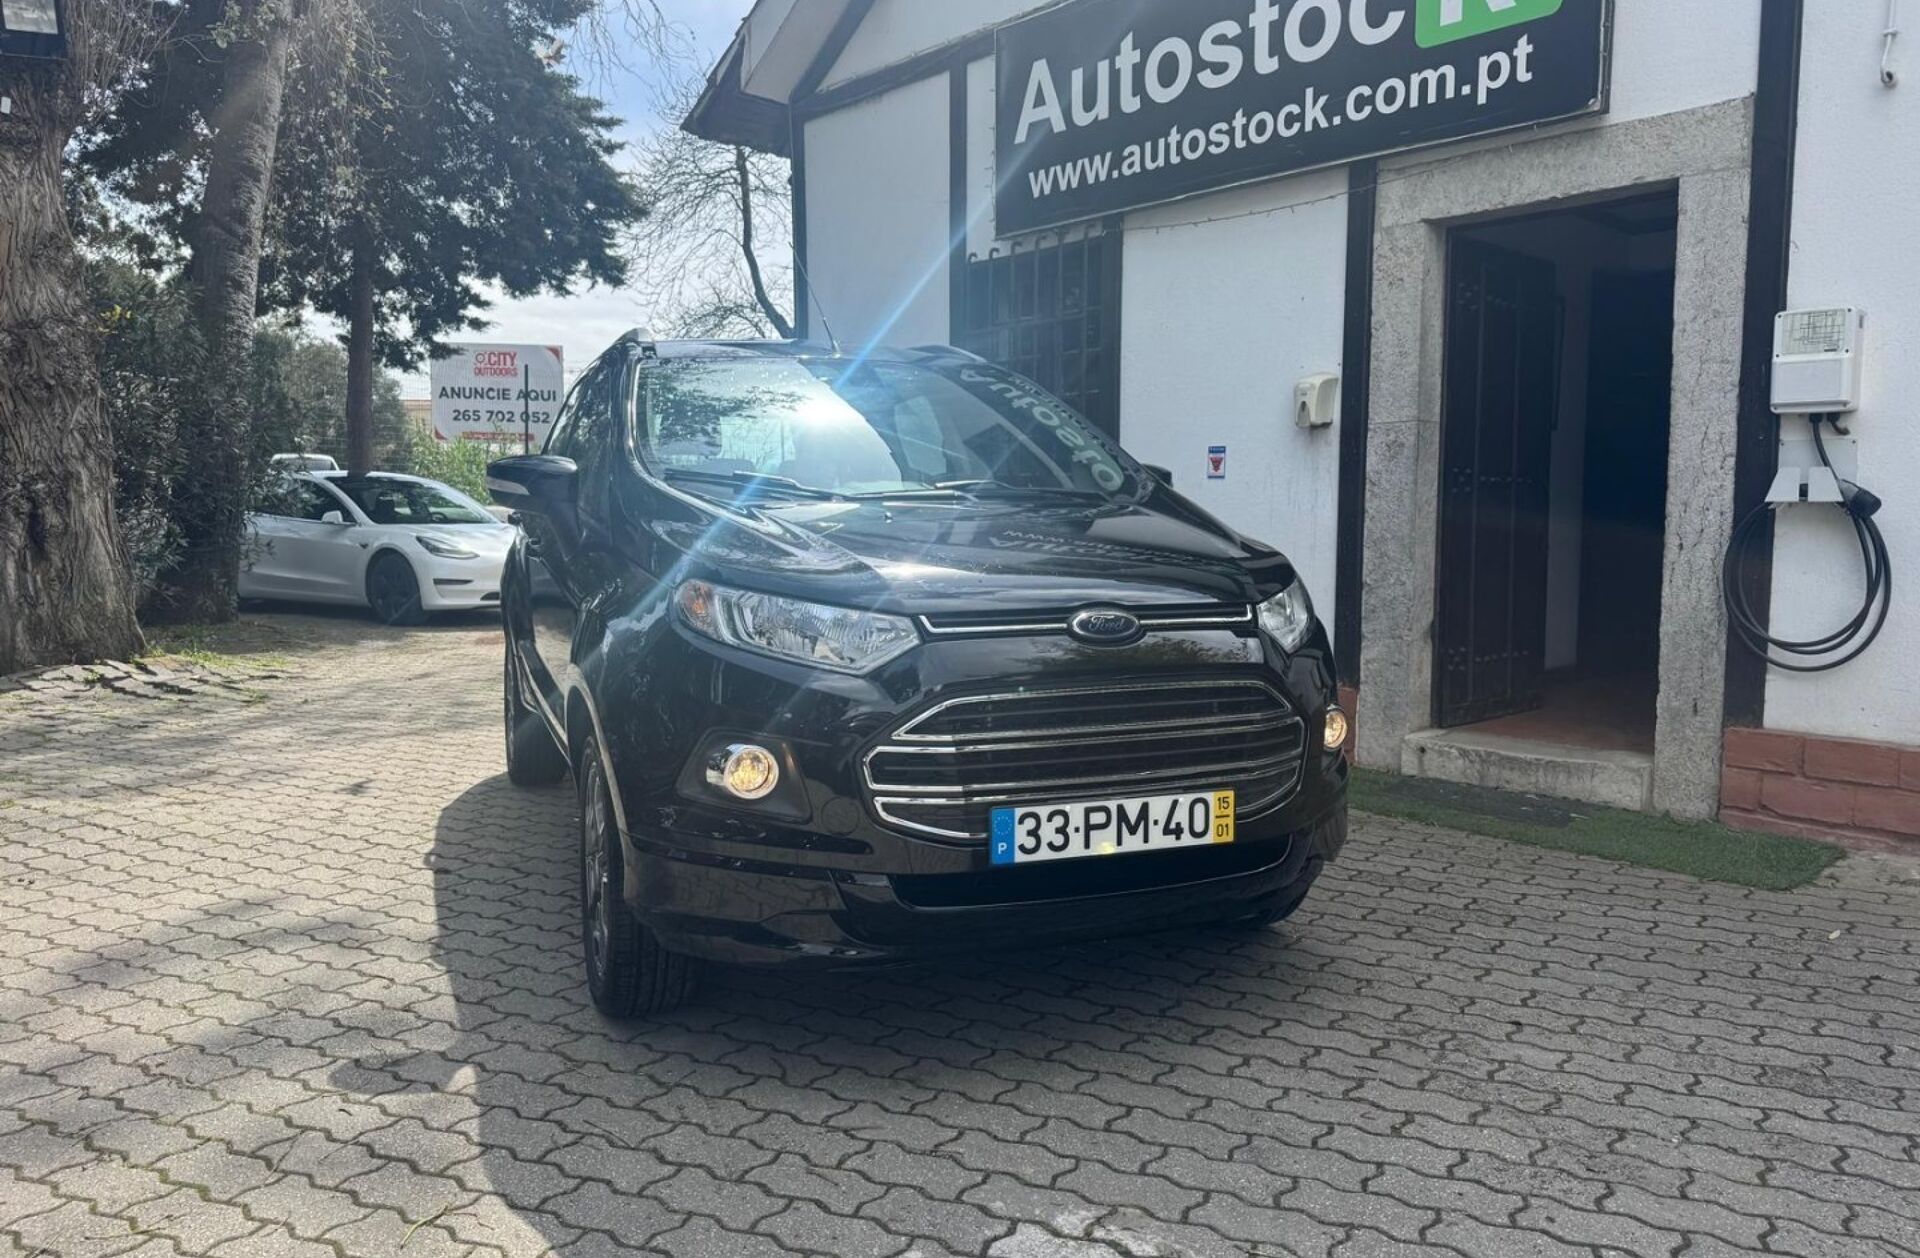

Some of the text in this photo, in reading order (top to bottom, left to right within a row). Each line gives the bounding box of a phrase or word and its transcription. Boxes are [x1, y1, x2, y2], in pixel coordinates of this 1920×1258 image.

[1014, 0, 1517, 144] Autostoc
[1028, 33, 1534, 198] www.autostock.com.pt
[488, 352, 518, 367] CITY
[474, 367, 518, 377] OUTDOORS
[439, 386, 557, 402] ANUNCIE AQUI
[452, 409, 550, 424] 265 702 052
[1088, 614, 1125, 632] Ford
[1217, 796, 1230, 811] 15
[1216, 823, 1230, 838] 01
[997, 842, 1008, 855] P
